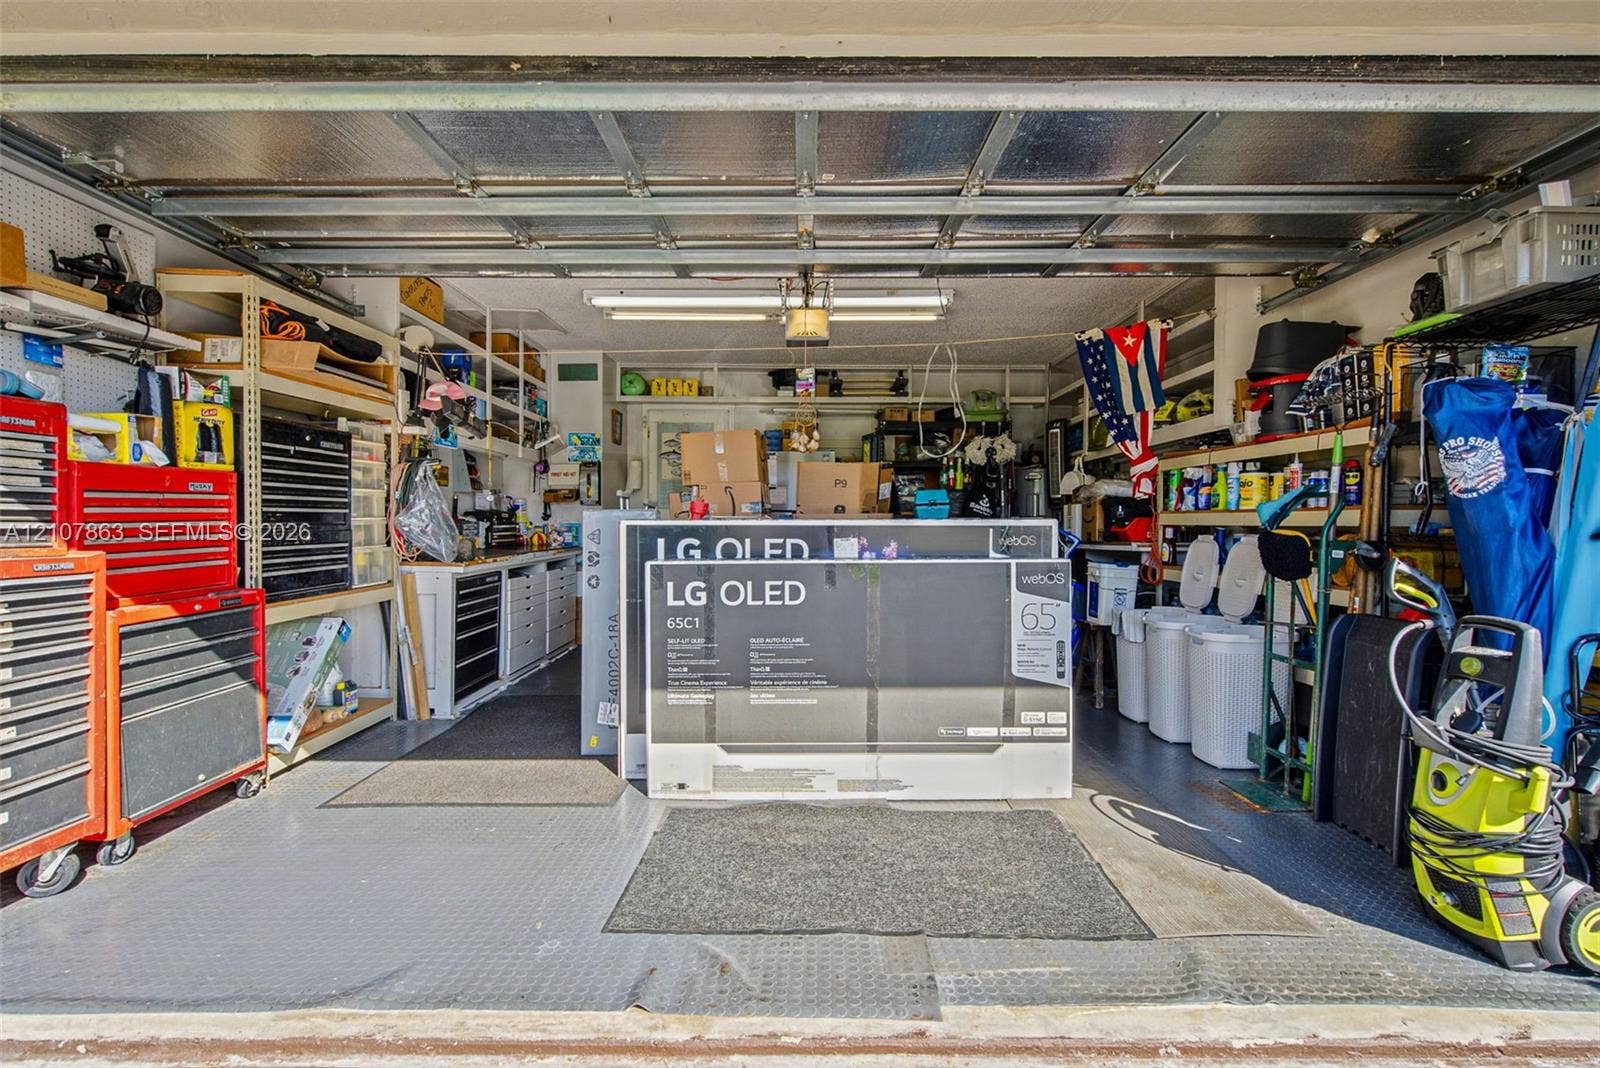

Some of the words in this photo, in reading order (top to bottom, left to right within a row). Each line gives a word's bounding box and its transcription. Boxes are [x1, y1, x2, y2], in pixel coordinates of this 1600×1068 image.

[1443, 437, 1465, 450] PRO
[1468, 437, 1500, 456] SHOPS
[834, 479, 847, 488] P9
[999, 535, 1037, 546] webOS
[657, 538, 701, 559] LG
[715, 538, 810, 559] OLED
[1021, 573, 1064, 585] webOS
[667, 581, 707, 606] LG
[720, 580, 806, 606] OLED
[667, 617, 699, 629] 65C1
